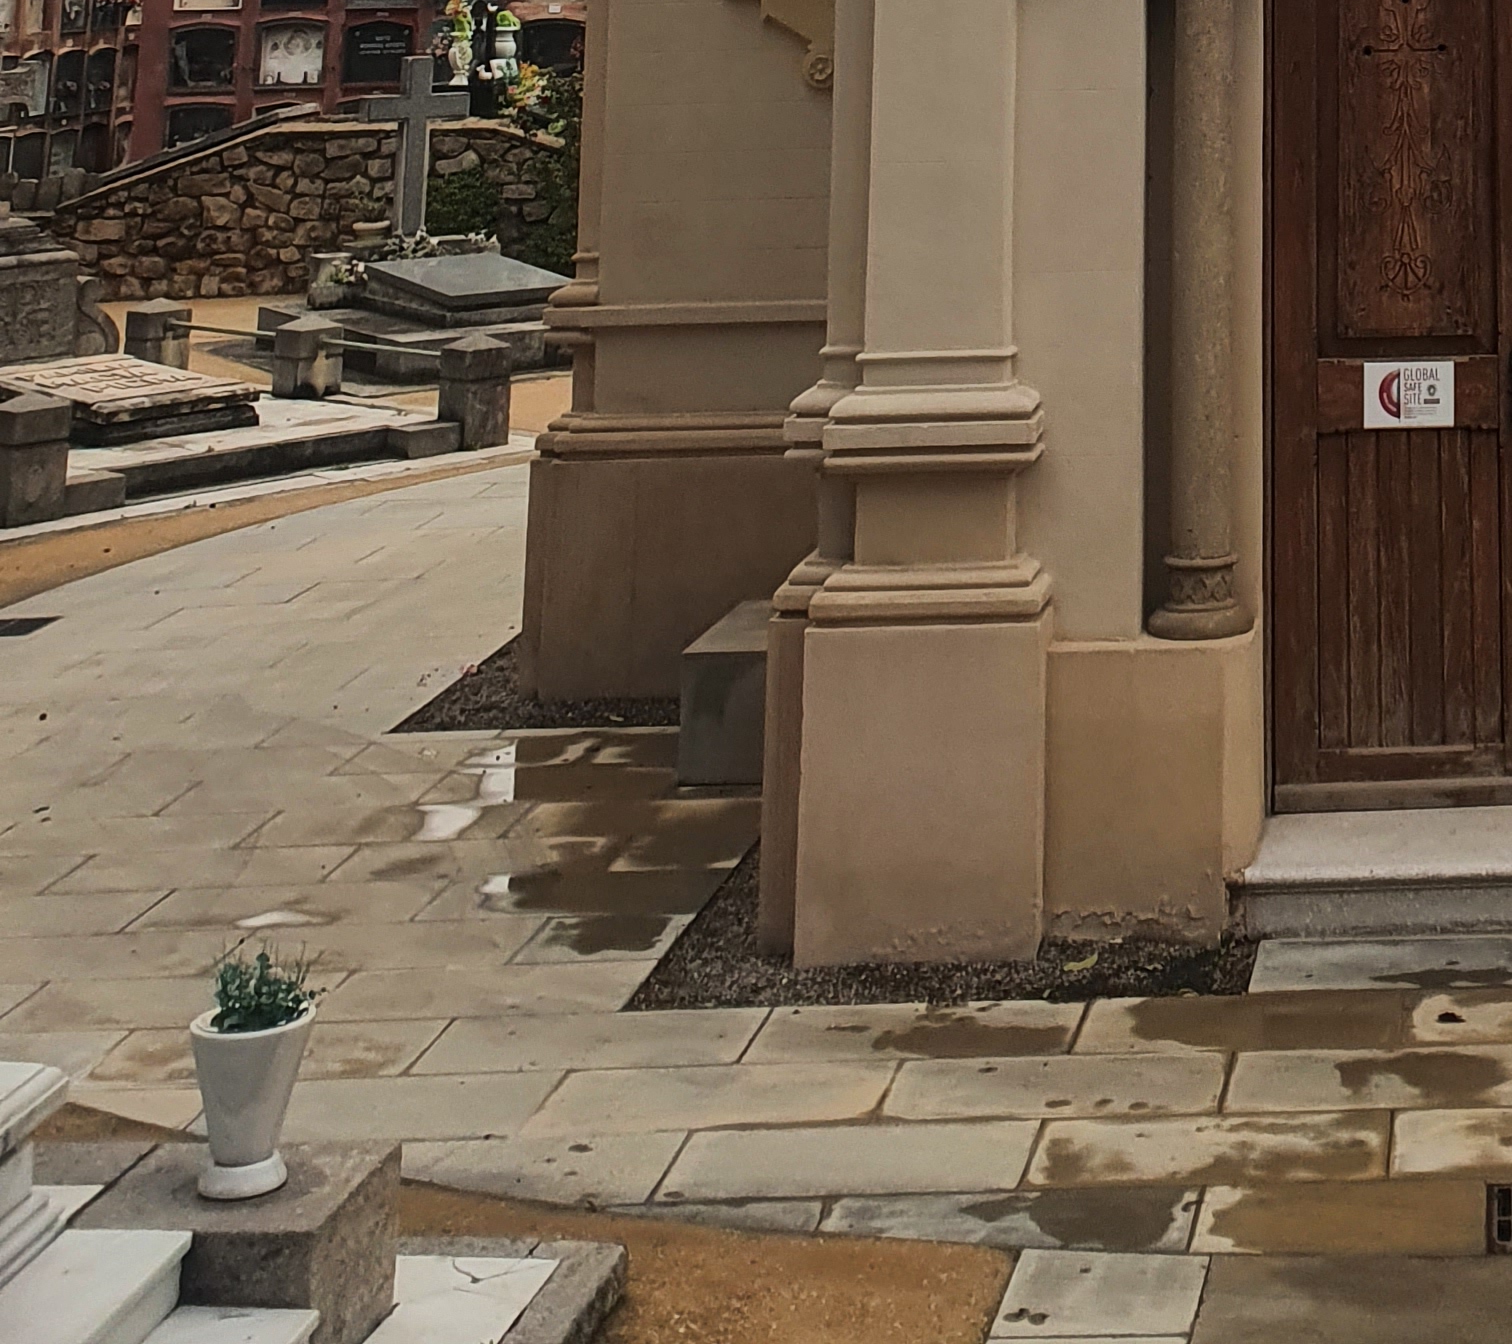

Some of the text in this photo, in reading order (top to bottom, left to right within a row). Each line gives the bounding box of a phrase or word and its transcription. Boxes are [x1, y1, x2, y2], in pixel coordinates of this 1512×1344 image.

[1403, 367, 1440, 381] GLOBAL
[1403, 382, 1422, 392] SAFE
[1403, 393, 1422, 405] SITE
